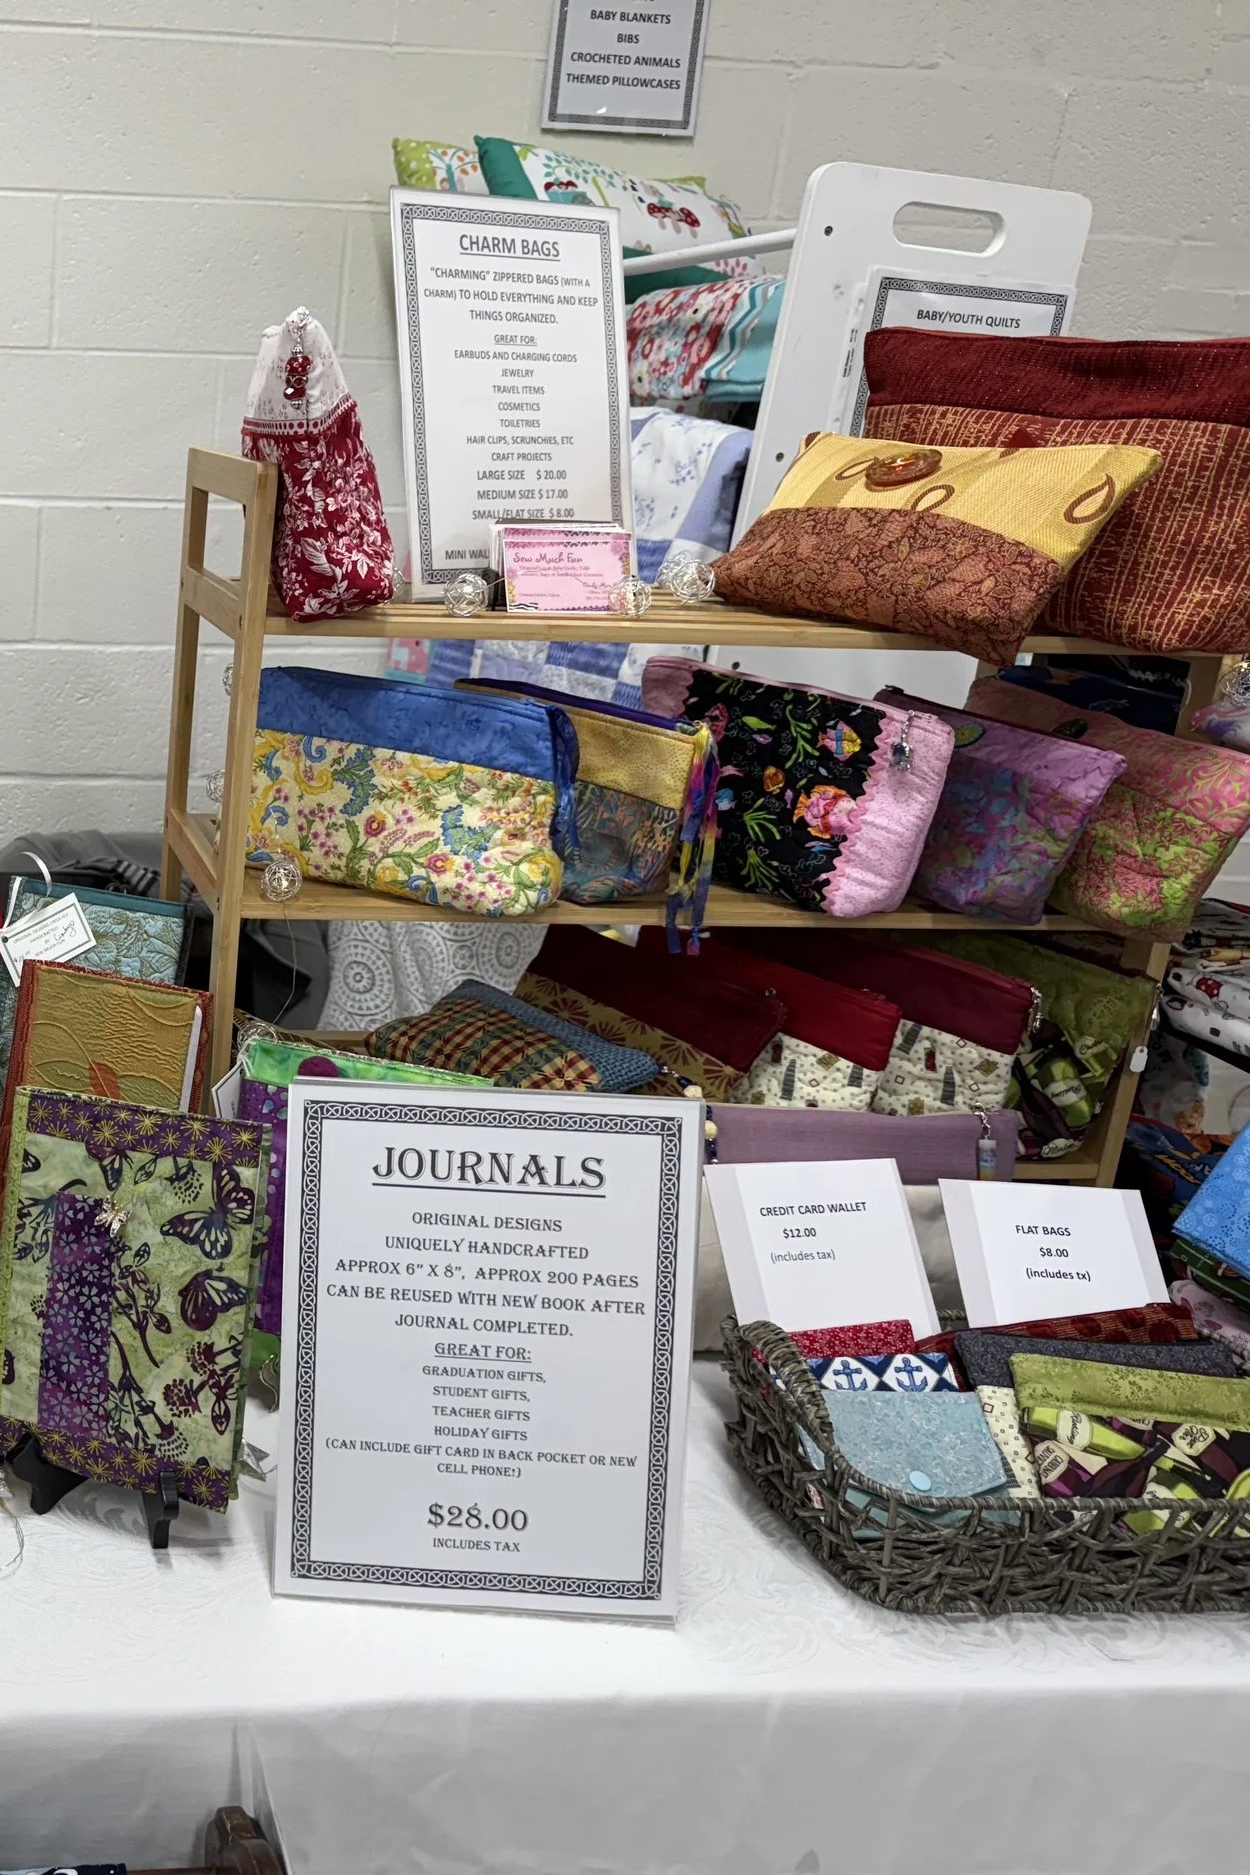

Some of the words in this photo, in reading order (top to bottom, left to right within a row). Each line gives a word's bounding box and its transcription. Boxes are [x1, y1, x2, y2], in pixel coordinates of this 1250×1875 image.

[590, 10, 618, 21] BABY
[620, 12, 671, 24] BLANKETS
[617, 34, 639, 43] BIBS
[571, 52, 631, 65] CROCHETED
[634, 57, 681, 68] ANIMALS
[566, 73, 610, 85] THEMED
[612, 76, 680, 90] PILLOWCASES
[459, 234, 516, 254] CHARM
[521, 240, 559, 258] BAGS
[492, 272, 533, 284] ZIPPERED
[536, 275, 558, 285] BAGS
[561, 277, 583, 288] (WITH
[585, 279, 590, 287] A
[424, 289, 457, 300] CHARM)
[459, 290, 471, 299] TO
[473, 290, 498, 301] HOLD
[501, 292, 554, 304] EVERYTHING
[557, 295, 575, 305] AND
[578, 296, 598, 306] KEEP
[470, 310, 502, 321] THINGS
[505, 312, 558, 324] ORGANIZED.
[917, 309, 983, 325] BABY/YOUTH
[986, 316, 1020, 328] QUILTS
[494, 334, 518, 344] GREAT
[454, 350, 490, 359] EARBUDS
[492, 352, 509, 360] AND
[511, 352, 550, 361] CHARGING
[552, 354, 577, 362] CORDS
[502, 369, 534, 377] JEWELRY
[493, 385, 520, 394] TRAVEL
[522, 386, 545, 394] ITEMS
[498, 402, 540, 411] COSMETICS
[500, 419, 540, 428] TOILETRIES
[467, 436, 485, 444] HAIR
[487, 436, 509, 445] CLIPS,
[492, 453, 515, 461] CRAFT
[517, 453, 552, 461] PROJECTS
[477, 471, 505, 480] LARGE
[508, 470, 525, 480] SIZE
[478, 490, 516, 499] MEDIUM
[519, 490, 535, 499] SIZE
[527, 509, 544, 518] SIZE
[445, 551, 468, 560] MINI
[470, 550, 490, 559] WAL
[514, 553, 532, 562] Sew
[536, 552, 564, 564] Much
[566, 553, 583, 562] Fun
[371, 1146, 606, 1190] JOURNALS
[760, 1206, 795, 1217] CREDIT
[798, 1204, 826, 1215] CARD
[829, 1201, 867, 1213] WALLET
[412, 1212, 489, 1228] ORIGINAL
[494, 1216, 563, 1232] DESIGNS
[783, 1227, 817, 1239] $12.00
[1016, 1225, 1039, 1236] FLAT
[1042, 1226, 1071, 1237] BAGS
[385, 1236, 465, 1253] UNIQUELY
[468, 1241, 589, 1259] HANDCRAFTED
[1039, 1246, 1069, 1258] $8.00
[770, 1250, 813, 1264] (includes
[816, 1249, 836, 1262] tax)
[335, 1259, 400, 1275] APPROX
[427, 1265, 439, 1277] X
[475, 1267, 541, 1283] APPROX
[547, 1272, 578, 1285] 200
[582, 1273, 639, 1288] PAGES
[1026, 1267, 1074, 1281] (includes
[1076, 1270, 1091, 1283] tx)
[326, 1285, 359, 1298] CAN
[364, 1287, 385, 1299] BE
[390, 1288, 452, 1304] REUSED
[457, 1290, 496, 1306] WITH
[501, 1294, 538, 1308] NEW
[541, 1297, 585, 1311] BOOK
[590, 1300, 645, 1315] AFTER
[395, 1313, 469, 1330] JOURNAL
[473, 1319, 573, 1336] COMPLETED.
[434, 1342, 491, 1358] GREAT
[496, 1346, 531, 1360] FOR:
[422, 1365, 504, 1380] GRADUATION
[507, 1371, 546, 1384] GIFTS,
[433, 1386, 488, 1398] STUDENT
[491, 1390, 530, 1402] GIFTS,
[432, 1406, 491, 1419] TEACHER
[494, 1410, 530, 1421] GIFTS
[434, 1426, 489, 1439] HOLIDAY
[491, 1429, 528, 1441] GIFTS
[326, 1438, 356, 1451] (CAN
[360, 1441, 410, 1454] INCLUDE
[414, 1444, 441, 1455] GIFT
[445, 1446, 479, 1458] CARD
[483, 1448, 495, 1459] IN
[498, 1450, 533, 1461] BACK
[537, 1452, 586, 1464] POCKET
[589, 1455, 606, 1465] OR
[610, 1456, 637, 1467] NEW
[437, 1463, 468, 1475] CELL
[471, 1465, 521, 1478] PHONE!)
[427, 1502, 528, 1531] $28.00
[433, 1538, 491, 1551] INCLUDES
[494, 1541, 520, 1553] TAX
